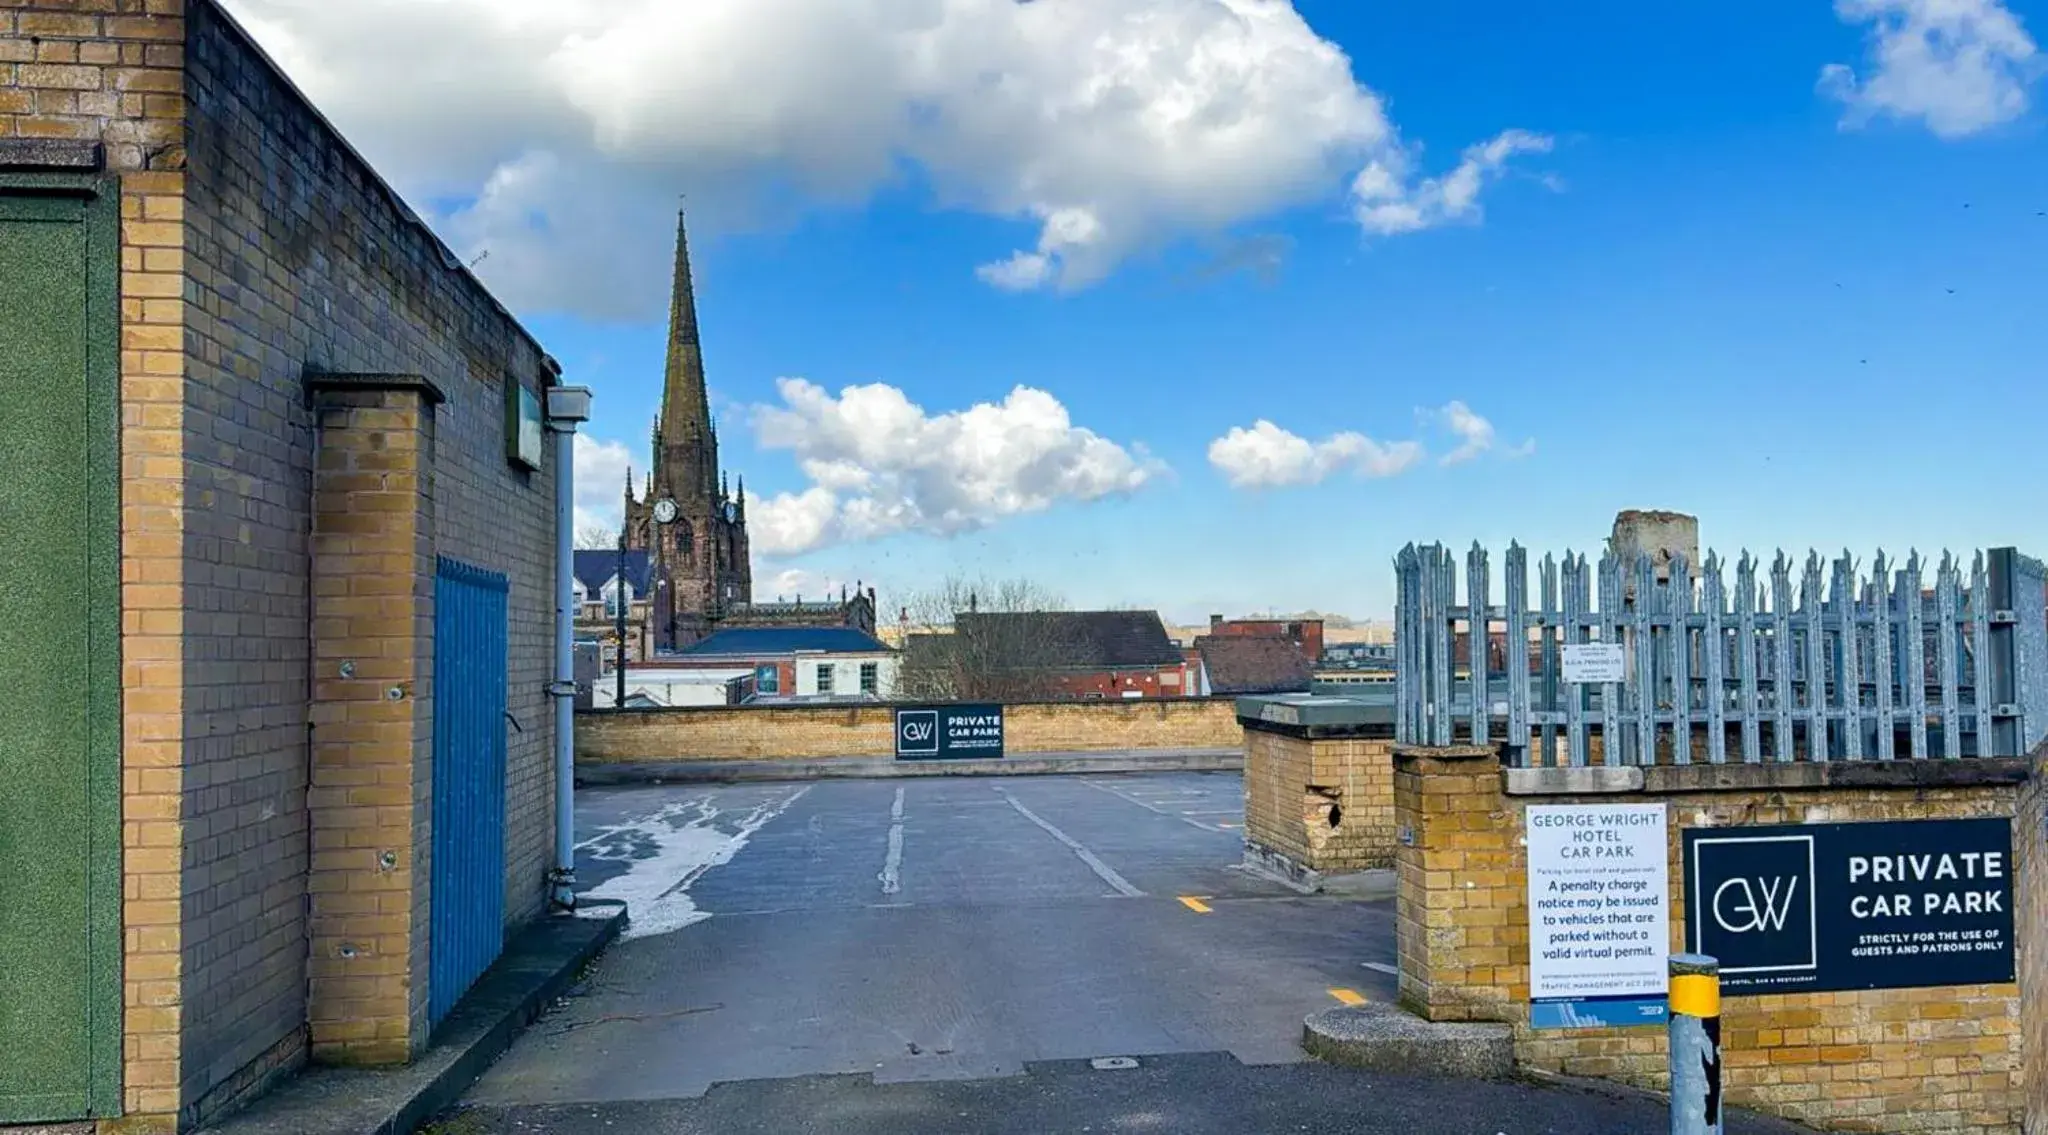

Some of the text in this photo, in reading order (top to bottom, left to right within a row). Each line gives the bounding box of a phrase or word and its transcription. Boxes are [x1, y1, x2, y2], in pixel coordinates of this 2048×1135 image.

[948, 716, 1000, 726] PRIVATE
[948, 728, 1000, 737] CAR PARK
[1533, 813, 1658, 827] GEORGE WRIGHT
[1573, 830, 1621, 842] HOTEL
[1561, 846, 1635, 859] CAR PARK
[1849, 852, 2003, 883] PRIVATE
[1548, 879, 1648, 894] A penalty charge
[1538, 895, 1659, 910] notice may be issued
[1713, 875, 1798, 933] GW
[1850, 890, 2003, 919] CAR PARK
[1543, 913, 1655, 926] to vehicles that are
[1550, 929, 1649, 944] parked without a
[1859, 929, 2000, 945] STRICTLY FOR THE USE OF
[1542, 946, 1655, 959] valid virtual permit.
[1851, 940, 2004, 957] GUESTS AND PATRONS ONLY
[1540, 982, 1571, 990] TRAFFIC
[1573, 981, 1624, 990] MANAGEMENT
